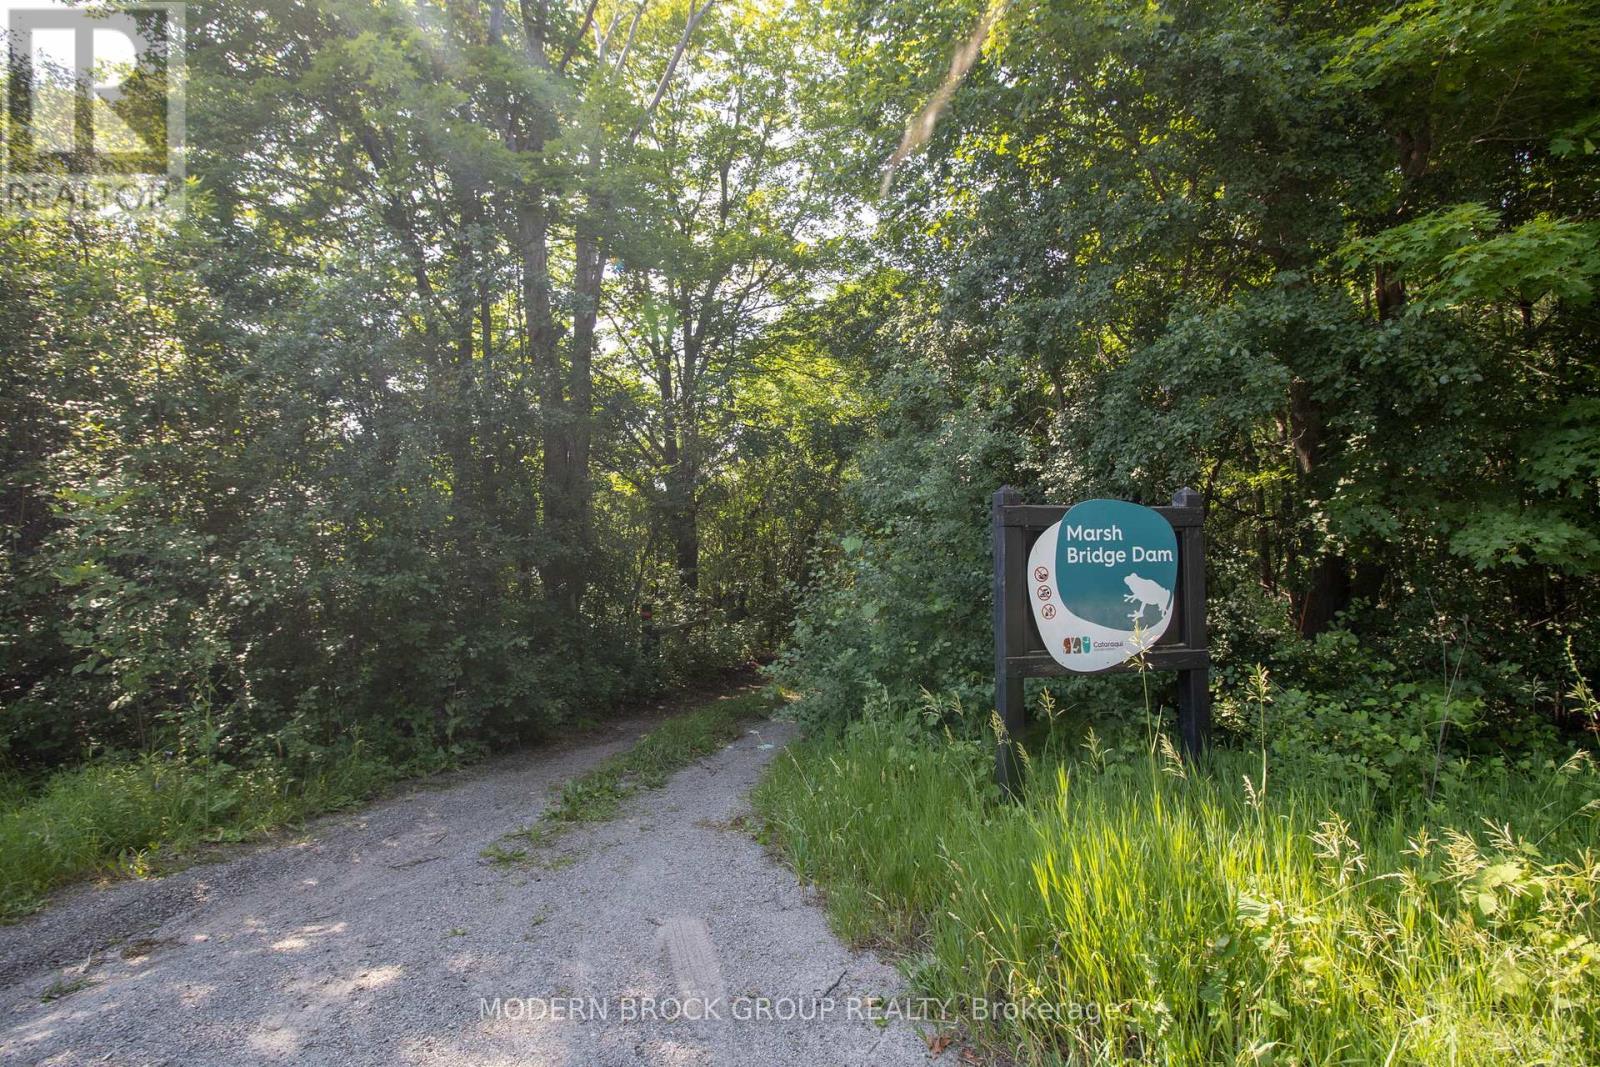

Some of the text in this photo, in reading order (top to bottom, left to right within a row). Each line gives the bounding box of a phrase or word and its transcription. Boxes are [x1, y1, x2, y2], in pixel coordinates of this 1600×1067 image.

[1066, 525, 1123, 541] Marsh
[1067, 546, 1173, 567] Bridge Dam
